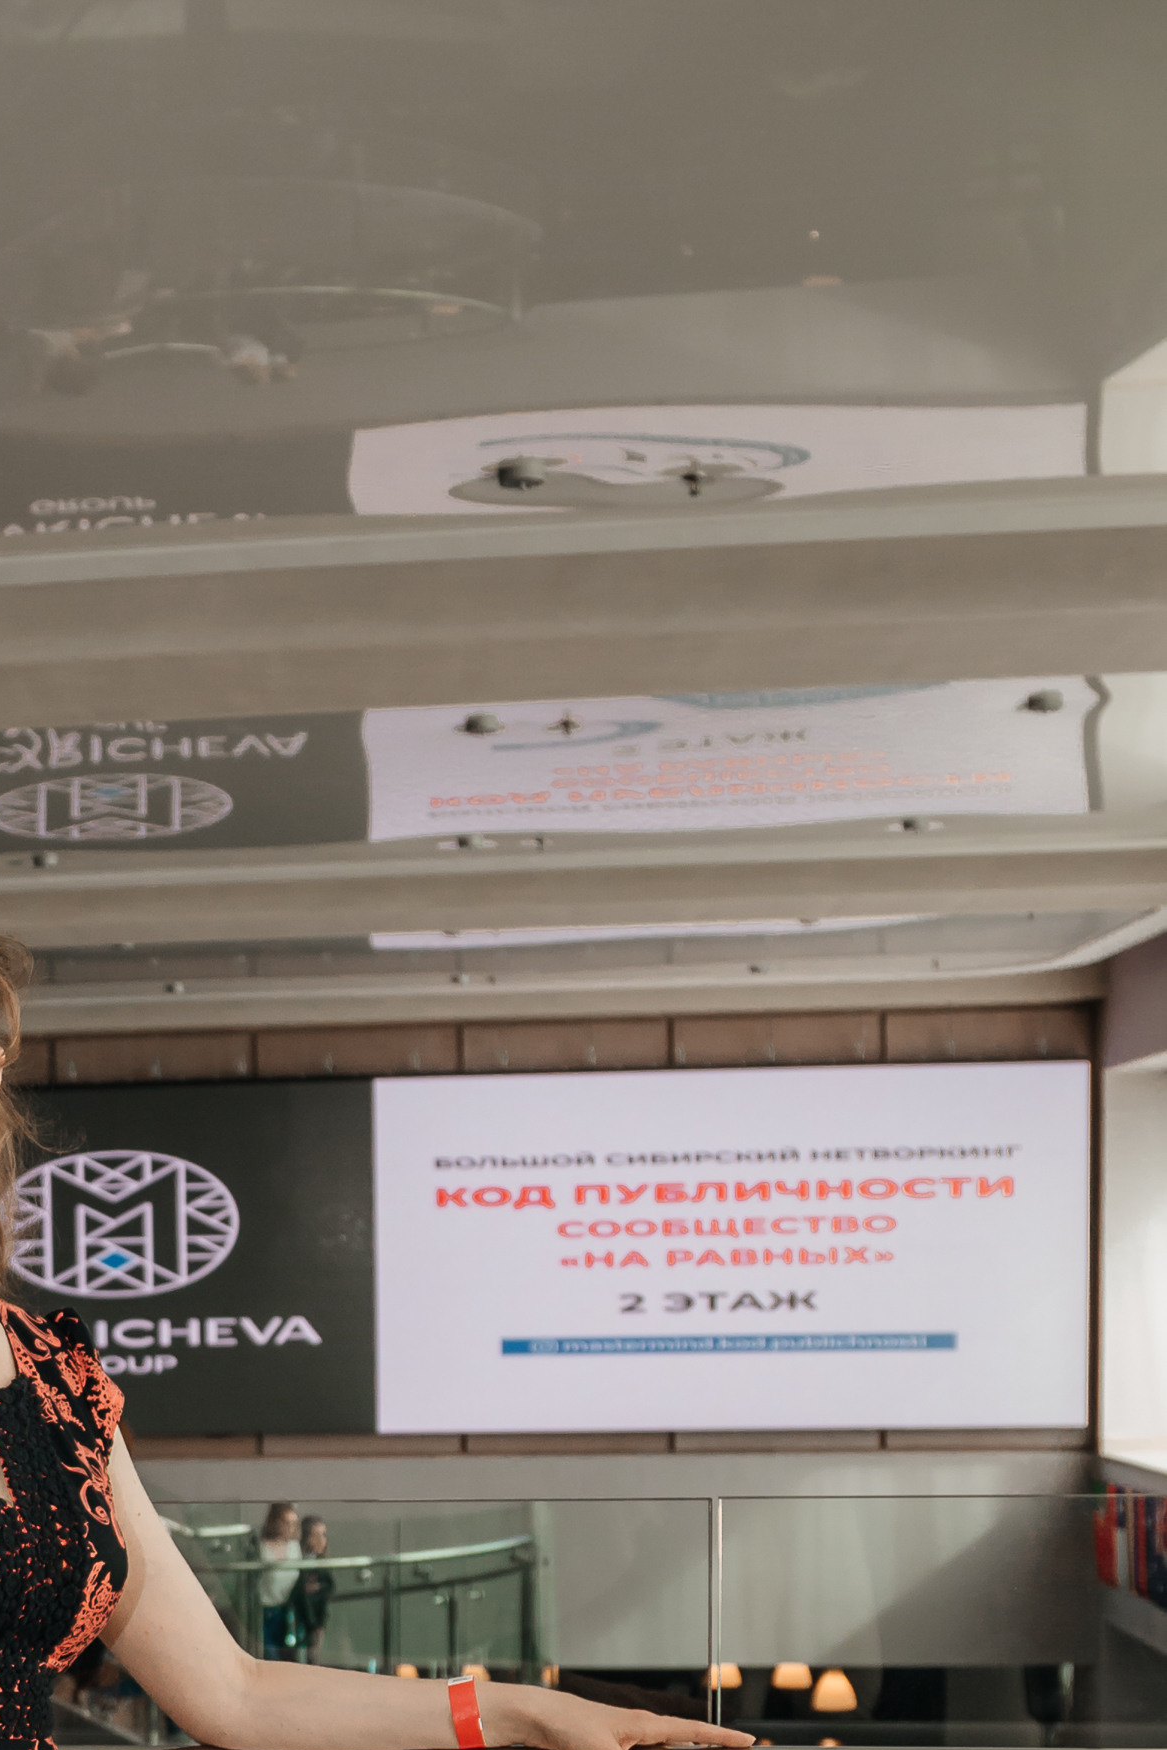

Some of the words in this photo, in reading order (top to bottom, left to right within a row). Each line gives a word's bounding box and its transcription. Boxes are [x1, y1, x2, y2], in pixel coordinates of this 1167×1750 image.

[435, 1152, 596, 1169] БОЛЬШОЙ
[607, 1147, 800, 1166] СИБИРСКИЙ
[810, 1144, 1022, 1161] НЕТВОРКИНГ
[436, 1186, 556, 1209] КОД
[574, 1175, 1014, 1205] ПУБЛИЧНОСТИ
[557, 1214, 897, 1238] СООБЩЕСТВО
[561, 1252, 649, 1268] «НА
[666, 1246, 894, 1266] РАВНЫХ»
[619, 1293, 646, 1313] 2
[664, 1290, 817, 1313] ЭТАЖ
[94, 1315, 323, 1349] ICHEVA
[101, 1354, 179, 1375] OUP
